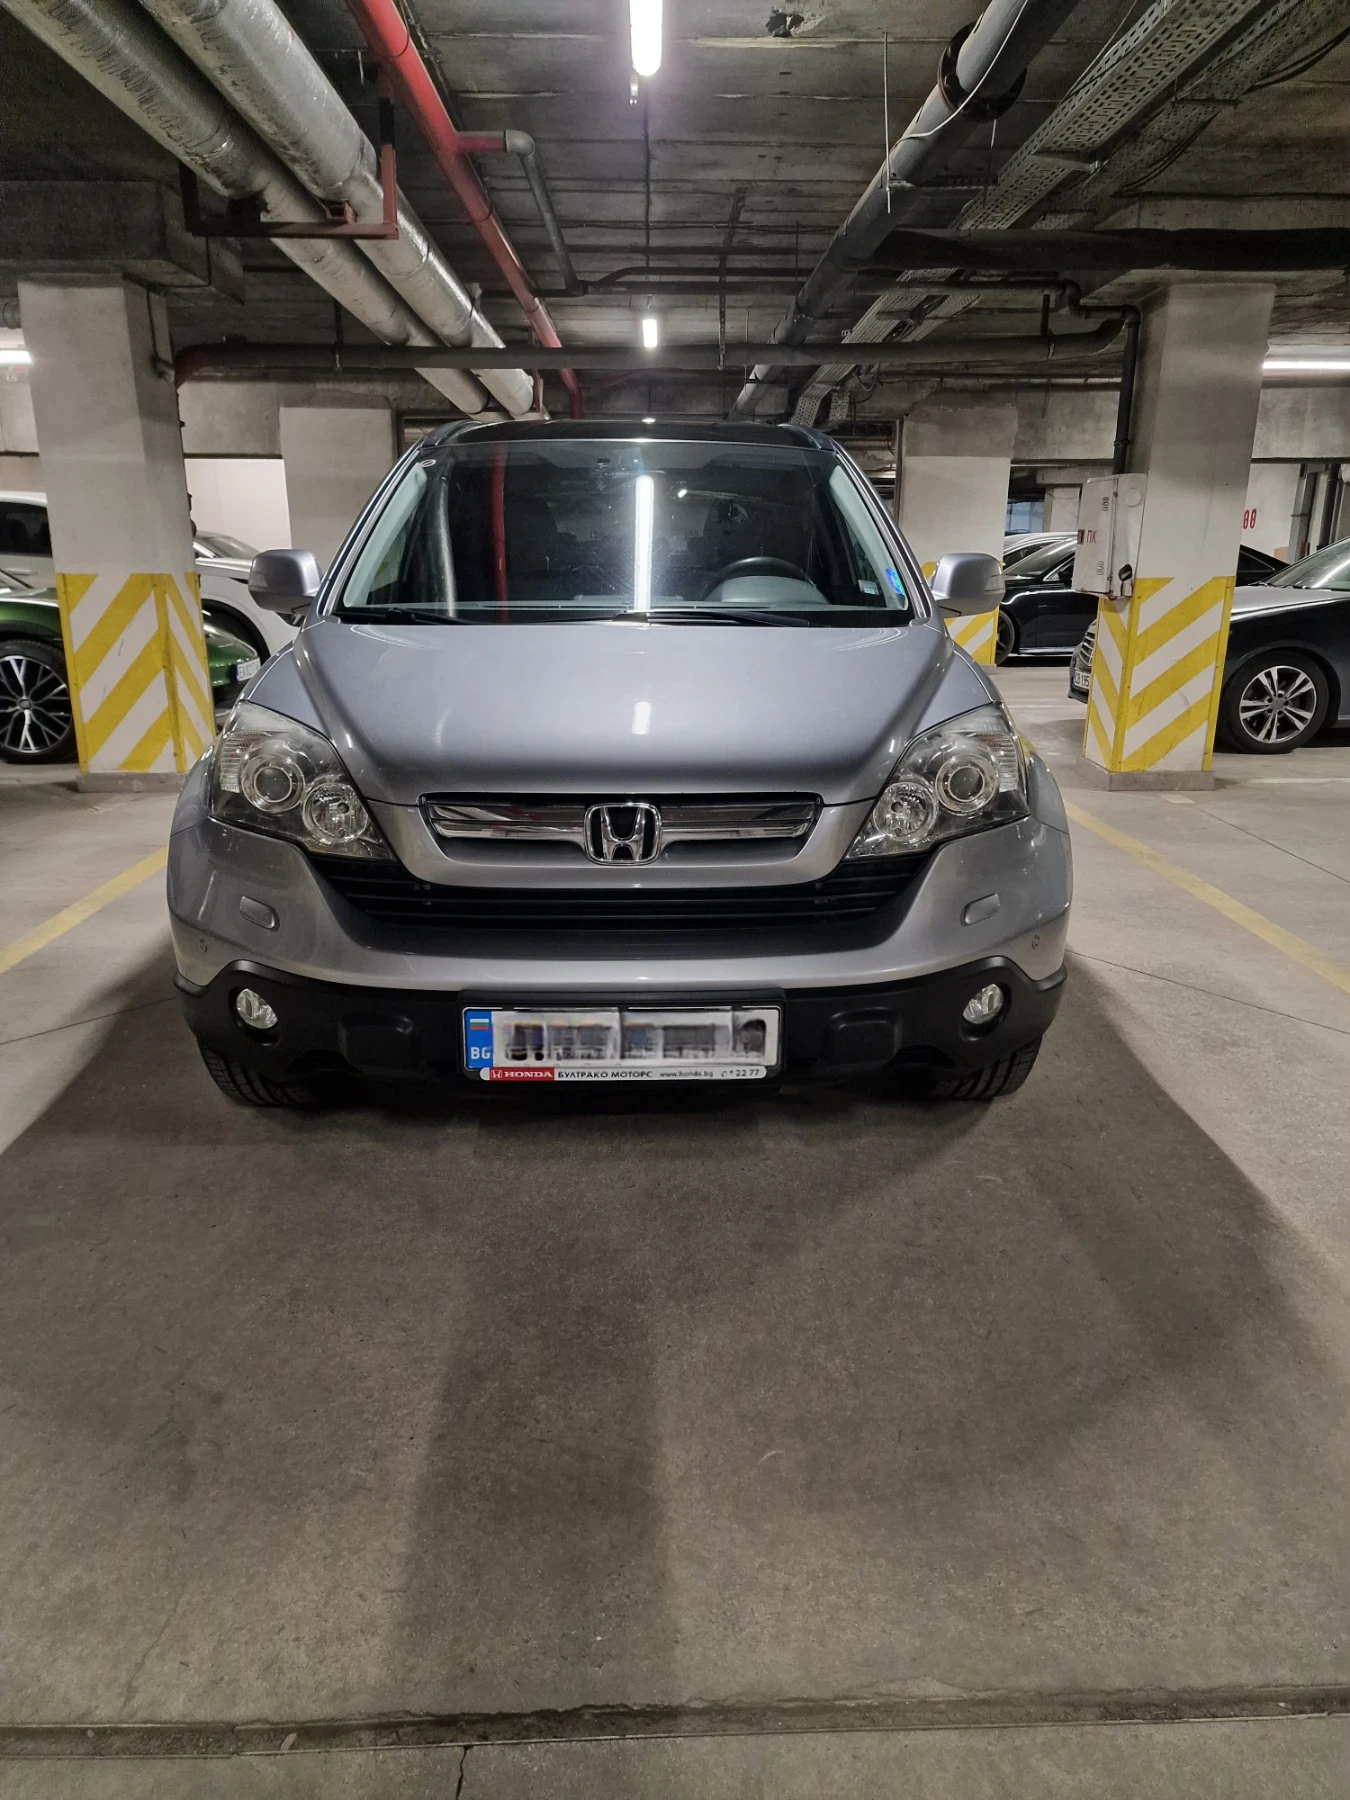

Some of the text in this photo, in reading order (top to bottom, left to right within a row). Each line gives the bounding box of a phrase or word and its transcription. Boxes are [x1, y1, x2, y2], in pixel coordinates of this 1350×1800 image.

[470, 1047, 491, 1060] BG
[504, 1071, 553, 1079] HONDA
[610, 1070, 653, 1079] МОТОРС
[659, 1070, 714, 1078] www.honda.bg
